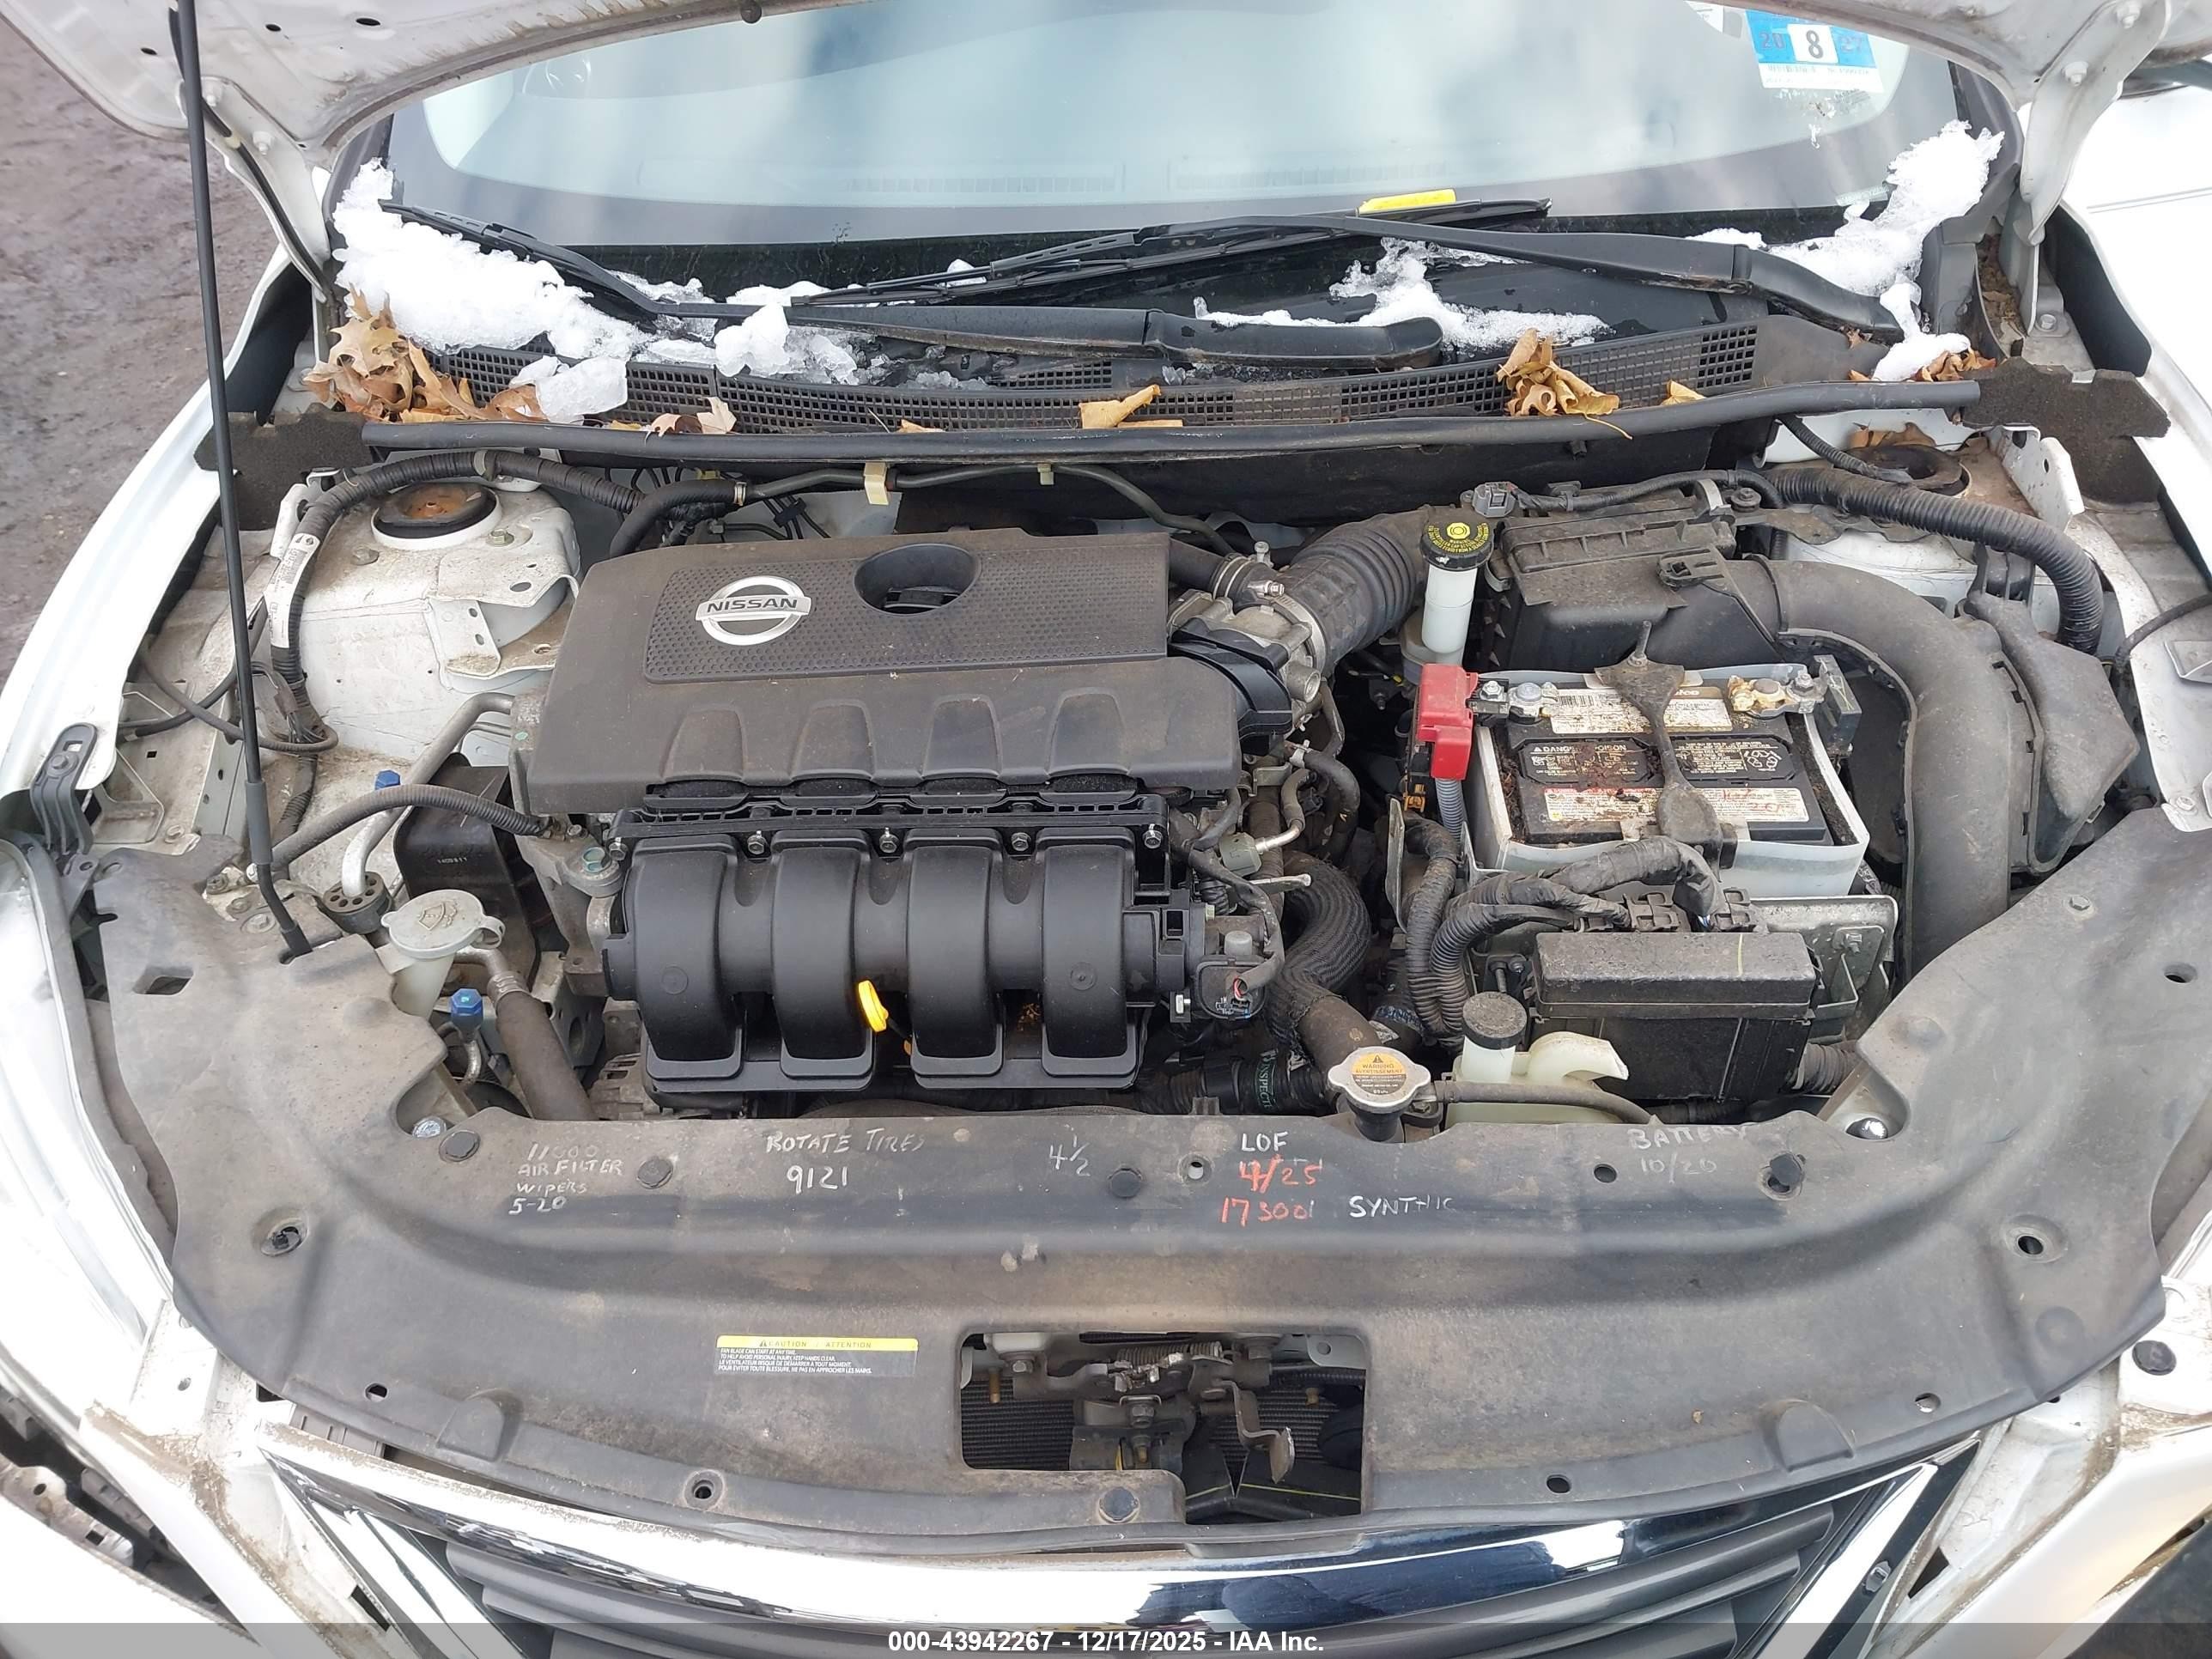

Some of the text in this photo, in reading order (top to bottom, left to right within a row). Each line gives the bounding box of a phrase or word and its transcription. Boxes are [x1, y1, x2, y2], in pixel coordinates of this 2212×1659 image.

[1806, 29, 1824, 59] 8
[707, 598, 798, 613] NISSAN
[766, 1130, 852, 1153] ROTATE
[1241, 1131, 1289, 1152] LOF
[1626, 1126, 1747, 1150] BATTERY
[518, 1158, 624, 1176] AIR FILTER
[516, 1178, 587, 1198] WIPERS
[508, 1195, 568, 1215] 5-20
[769, 1339, 807, 1347] CAUTION
